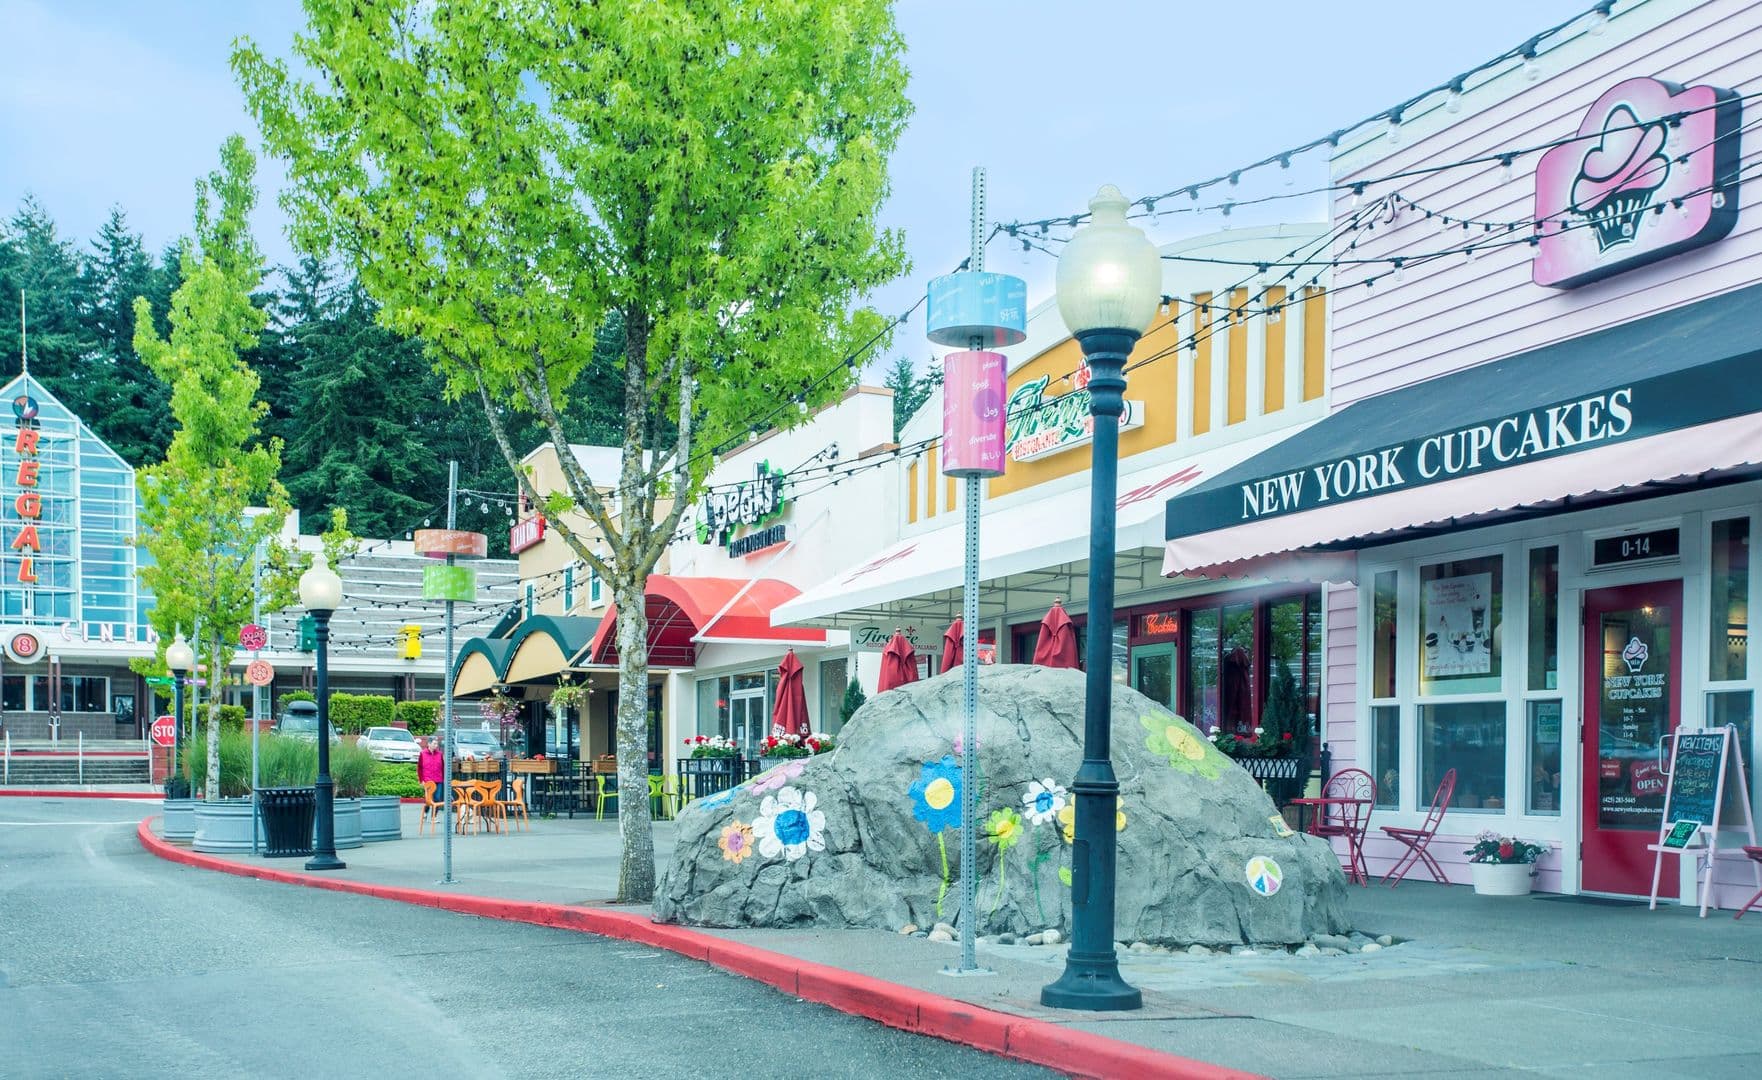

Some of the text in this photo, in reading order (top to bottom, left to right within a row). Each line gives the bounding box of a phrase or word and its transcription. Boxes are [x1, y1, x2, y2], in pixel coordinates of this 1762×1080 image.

[1241, 388, 1633, 519] NEW YORK CUPCAKES
[11, 428, 41, 583] REGAL
[18, 638, 32, 652] 8
[1605, 673, 1665, 688] NEW YORK
[1608, 687, 1662, 700] CUPCAKES
[154, 725, 175, 738] STO
[1637, 779, 1664, 790] OPEN
